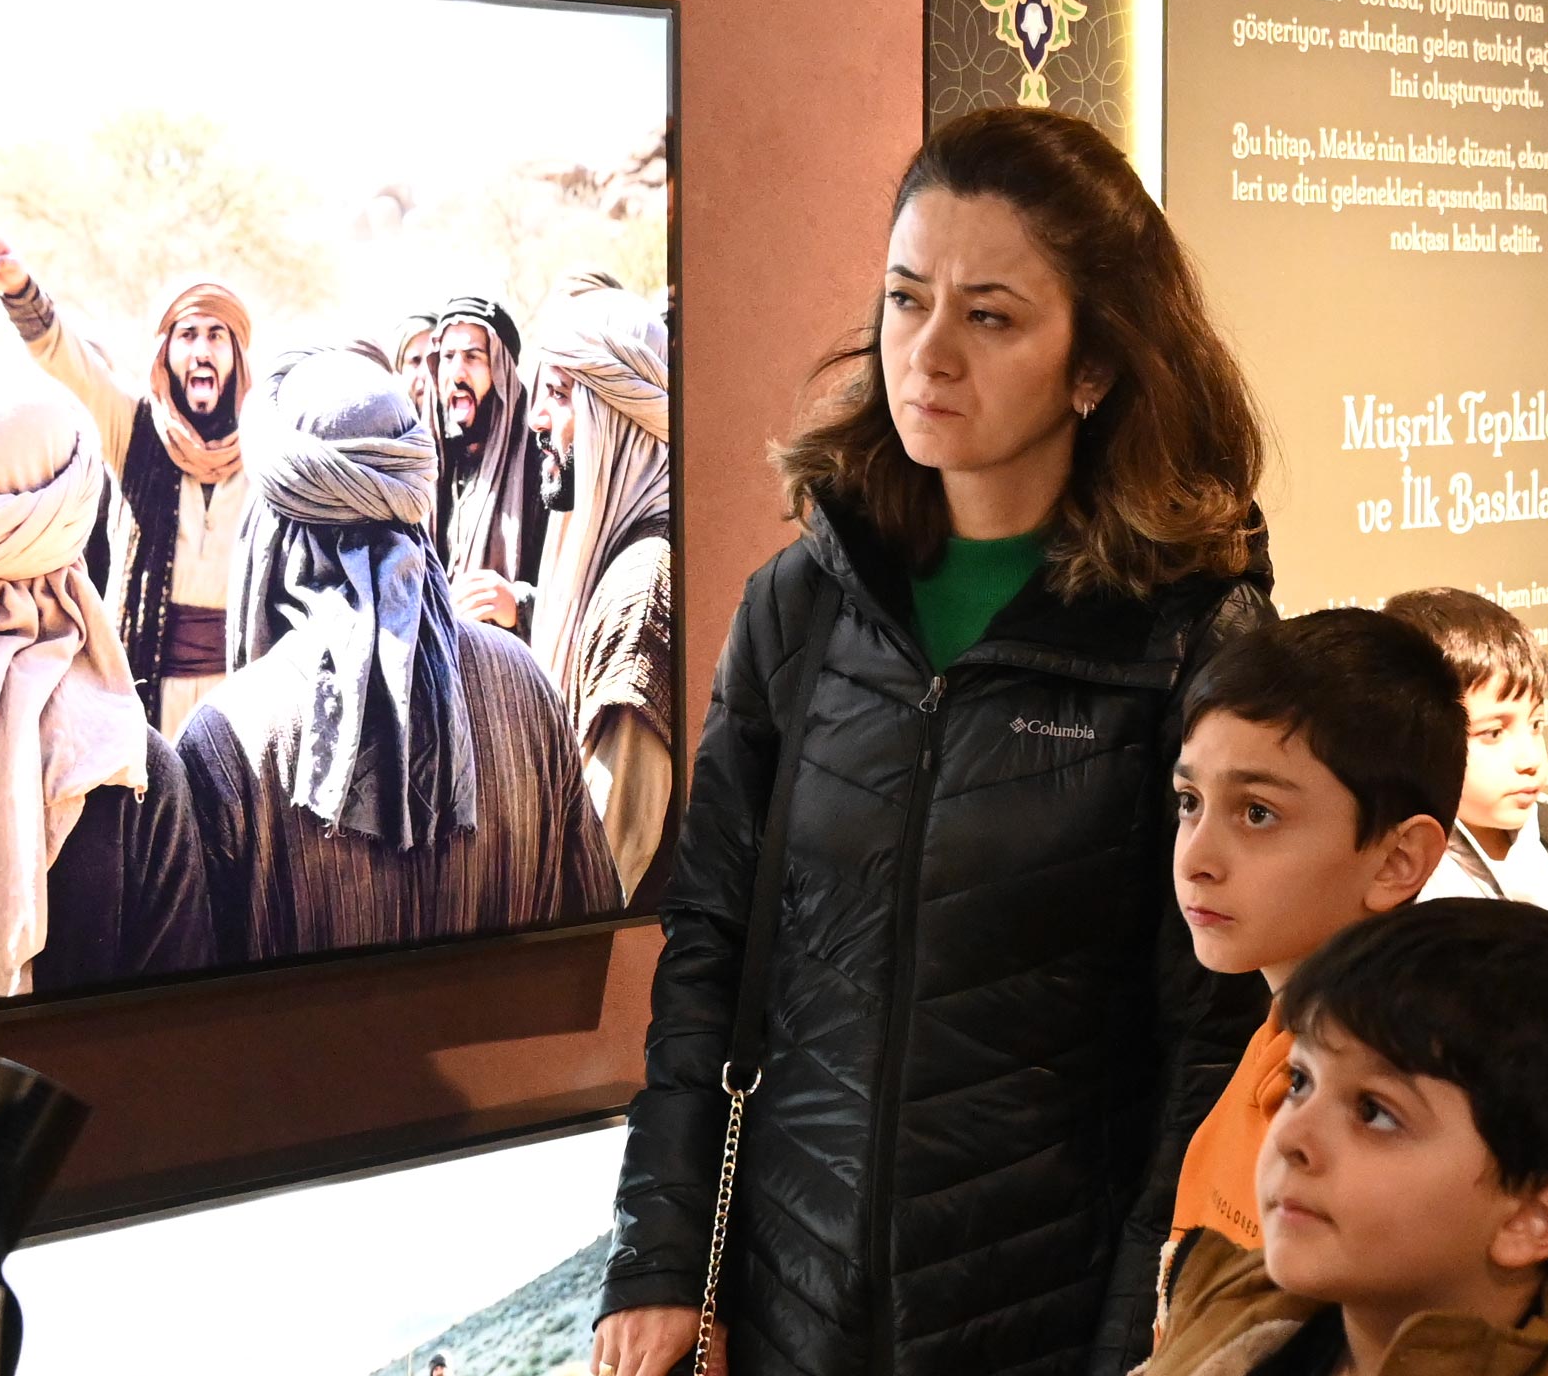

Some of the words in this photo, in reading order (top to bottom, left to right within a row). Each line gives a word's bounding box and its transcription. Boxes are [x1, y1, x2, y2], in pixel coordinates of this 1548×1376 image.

[1515, 4, 1544, 23] ona
[1233, 13, 1333, 52] gösteriyor,
[1339, 21, 1418, 55] ardından
[1423, 29, 1468, 63] gelen
[1473, 34, 1522, 66] tevhid
[1390, 68, 1418, 97] lini
[1422, 71, 1544, 112] oluşturuyordu.
[1232, 122, 1261, 159] Bu
[1265, 125, 1315, 165] hitap,
[1408, 134, 1456, 165] kabile
[1459, 137, 1515, 170] düzeni,
[1232, 170, 1262, 201] leri
[1267, 183, 1287, 202] ve
[1292, 173, 1327, 205] dini
[1331, 176, 1423, 212] gelenekleri
[1427, 181, 1502, 215] açısından
[1506, 176, 1547, 214] İslam
[1391, 222, 1449, 253] noktası
[1453, 223, 1496, 252] kabul
[1500, 225, 1542, 255] edilir.
[1342, 394, 1453, 461] Müşrik
[1358, 499, 1391, 533] ve
[1401, 466, 1441, 529] İlk
[1027, 720, 1095, 740] Columbia
